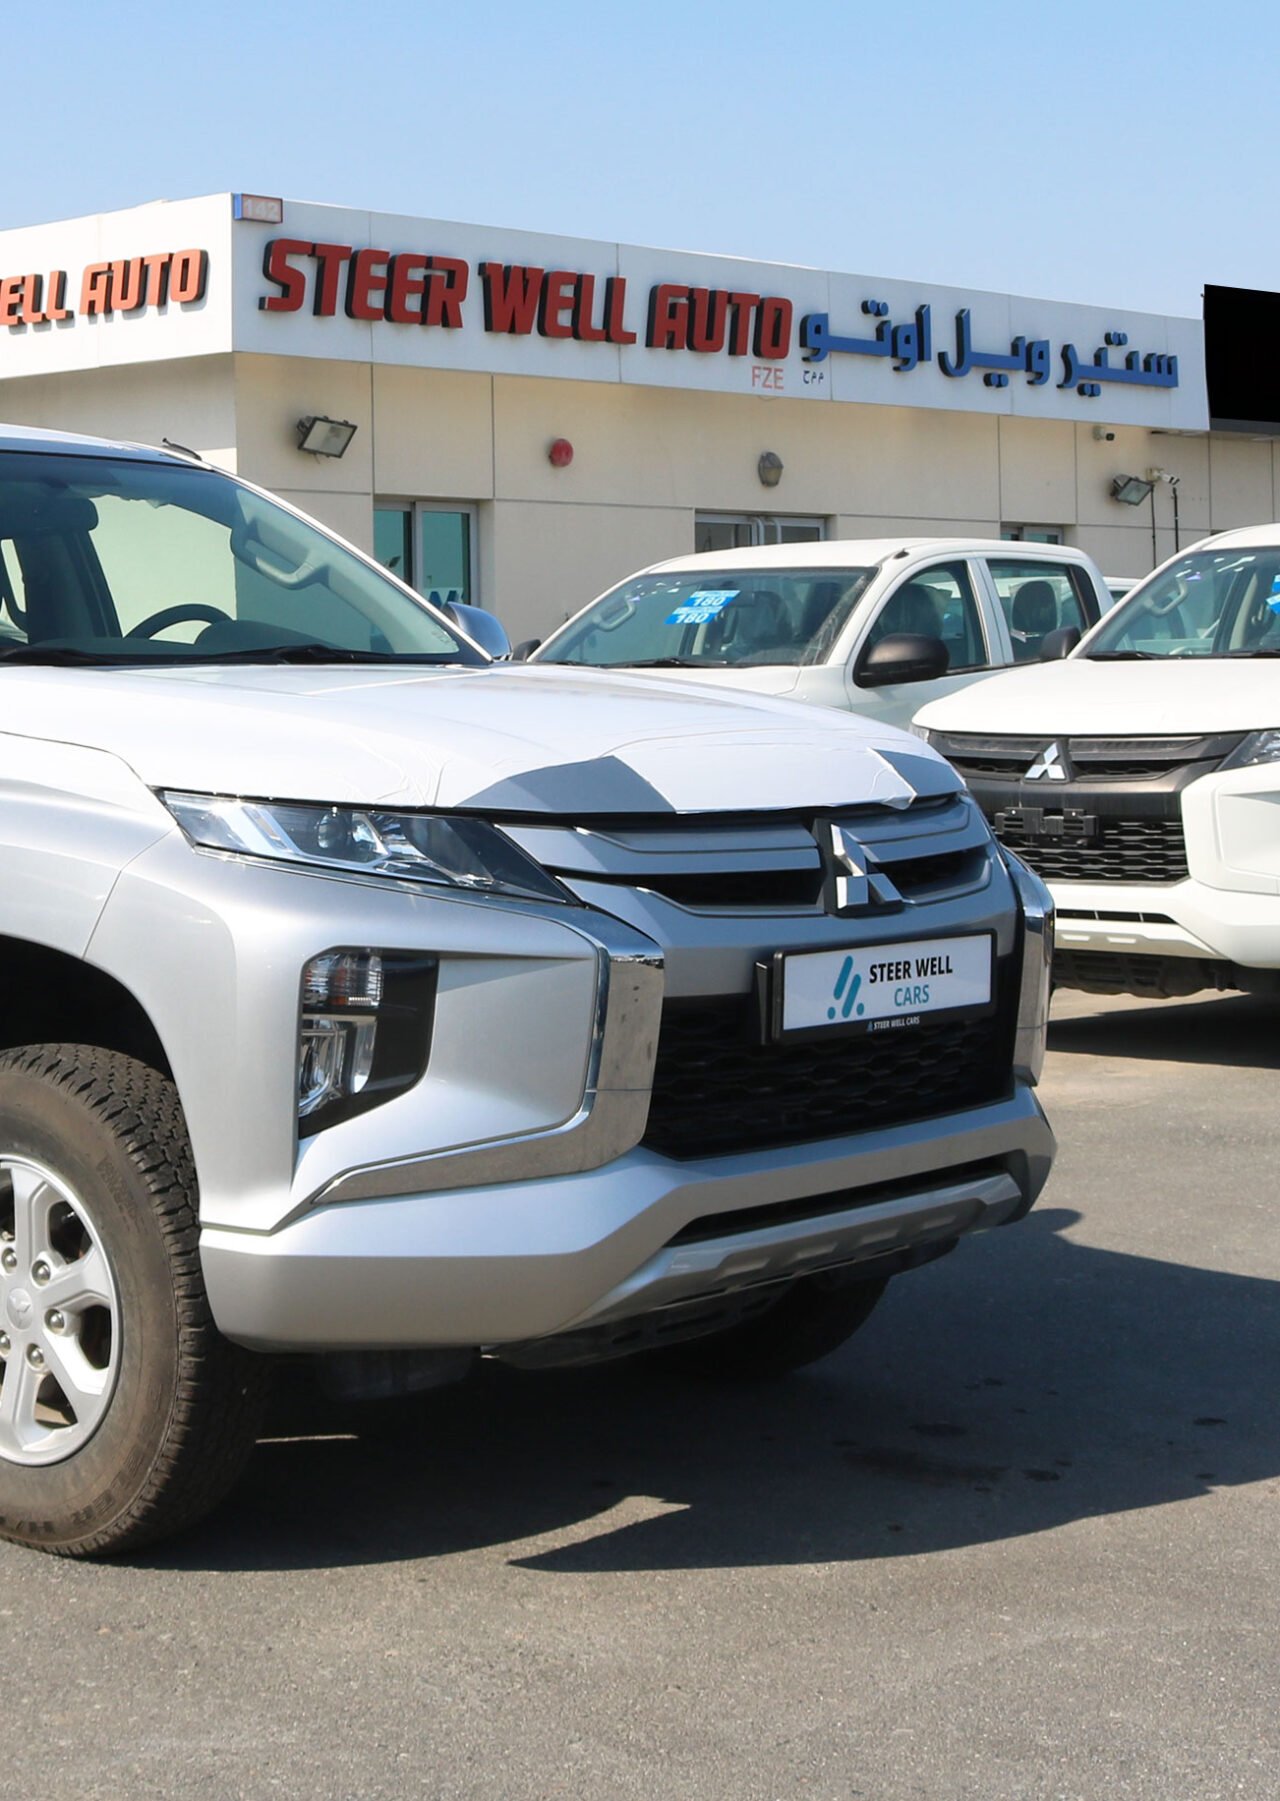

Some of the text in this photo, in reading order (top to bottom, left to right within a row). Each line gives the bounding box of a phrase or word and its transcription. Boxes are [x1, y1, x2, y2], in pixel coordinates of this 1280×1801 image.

[80, 249, 207, 317] AUTO
[258, 238, 793, 360] STEER WELL AUTO
[751, 365, 785, 391] FZE
[692, 596, 727, 607] 180
[675, 613, 710, 624] 180
[869, 955, 953, 984] STEER WELL
[894, 984, 930, 1007] CARS
[873, 1015, 921, 1031] STEER WELL CARS
